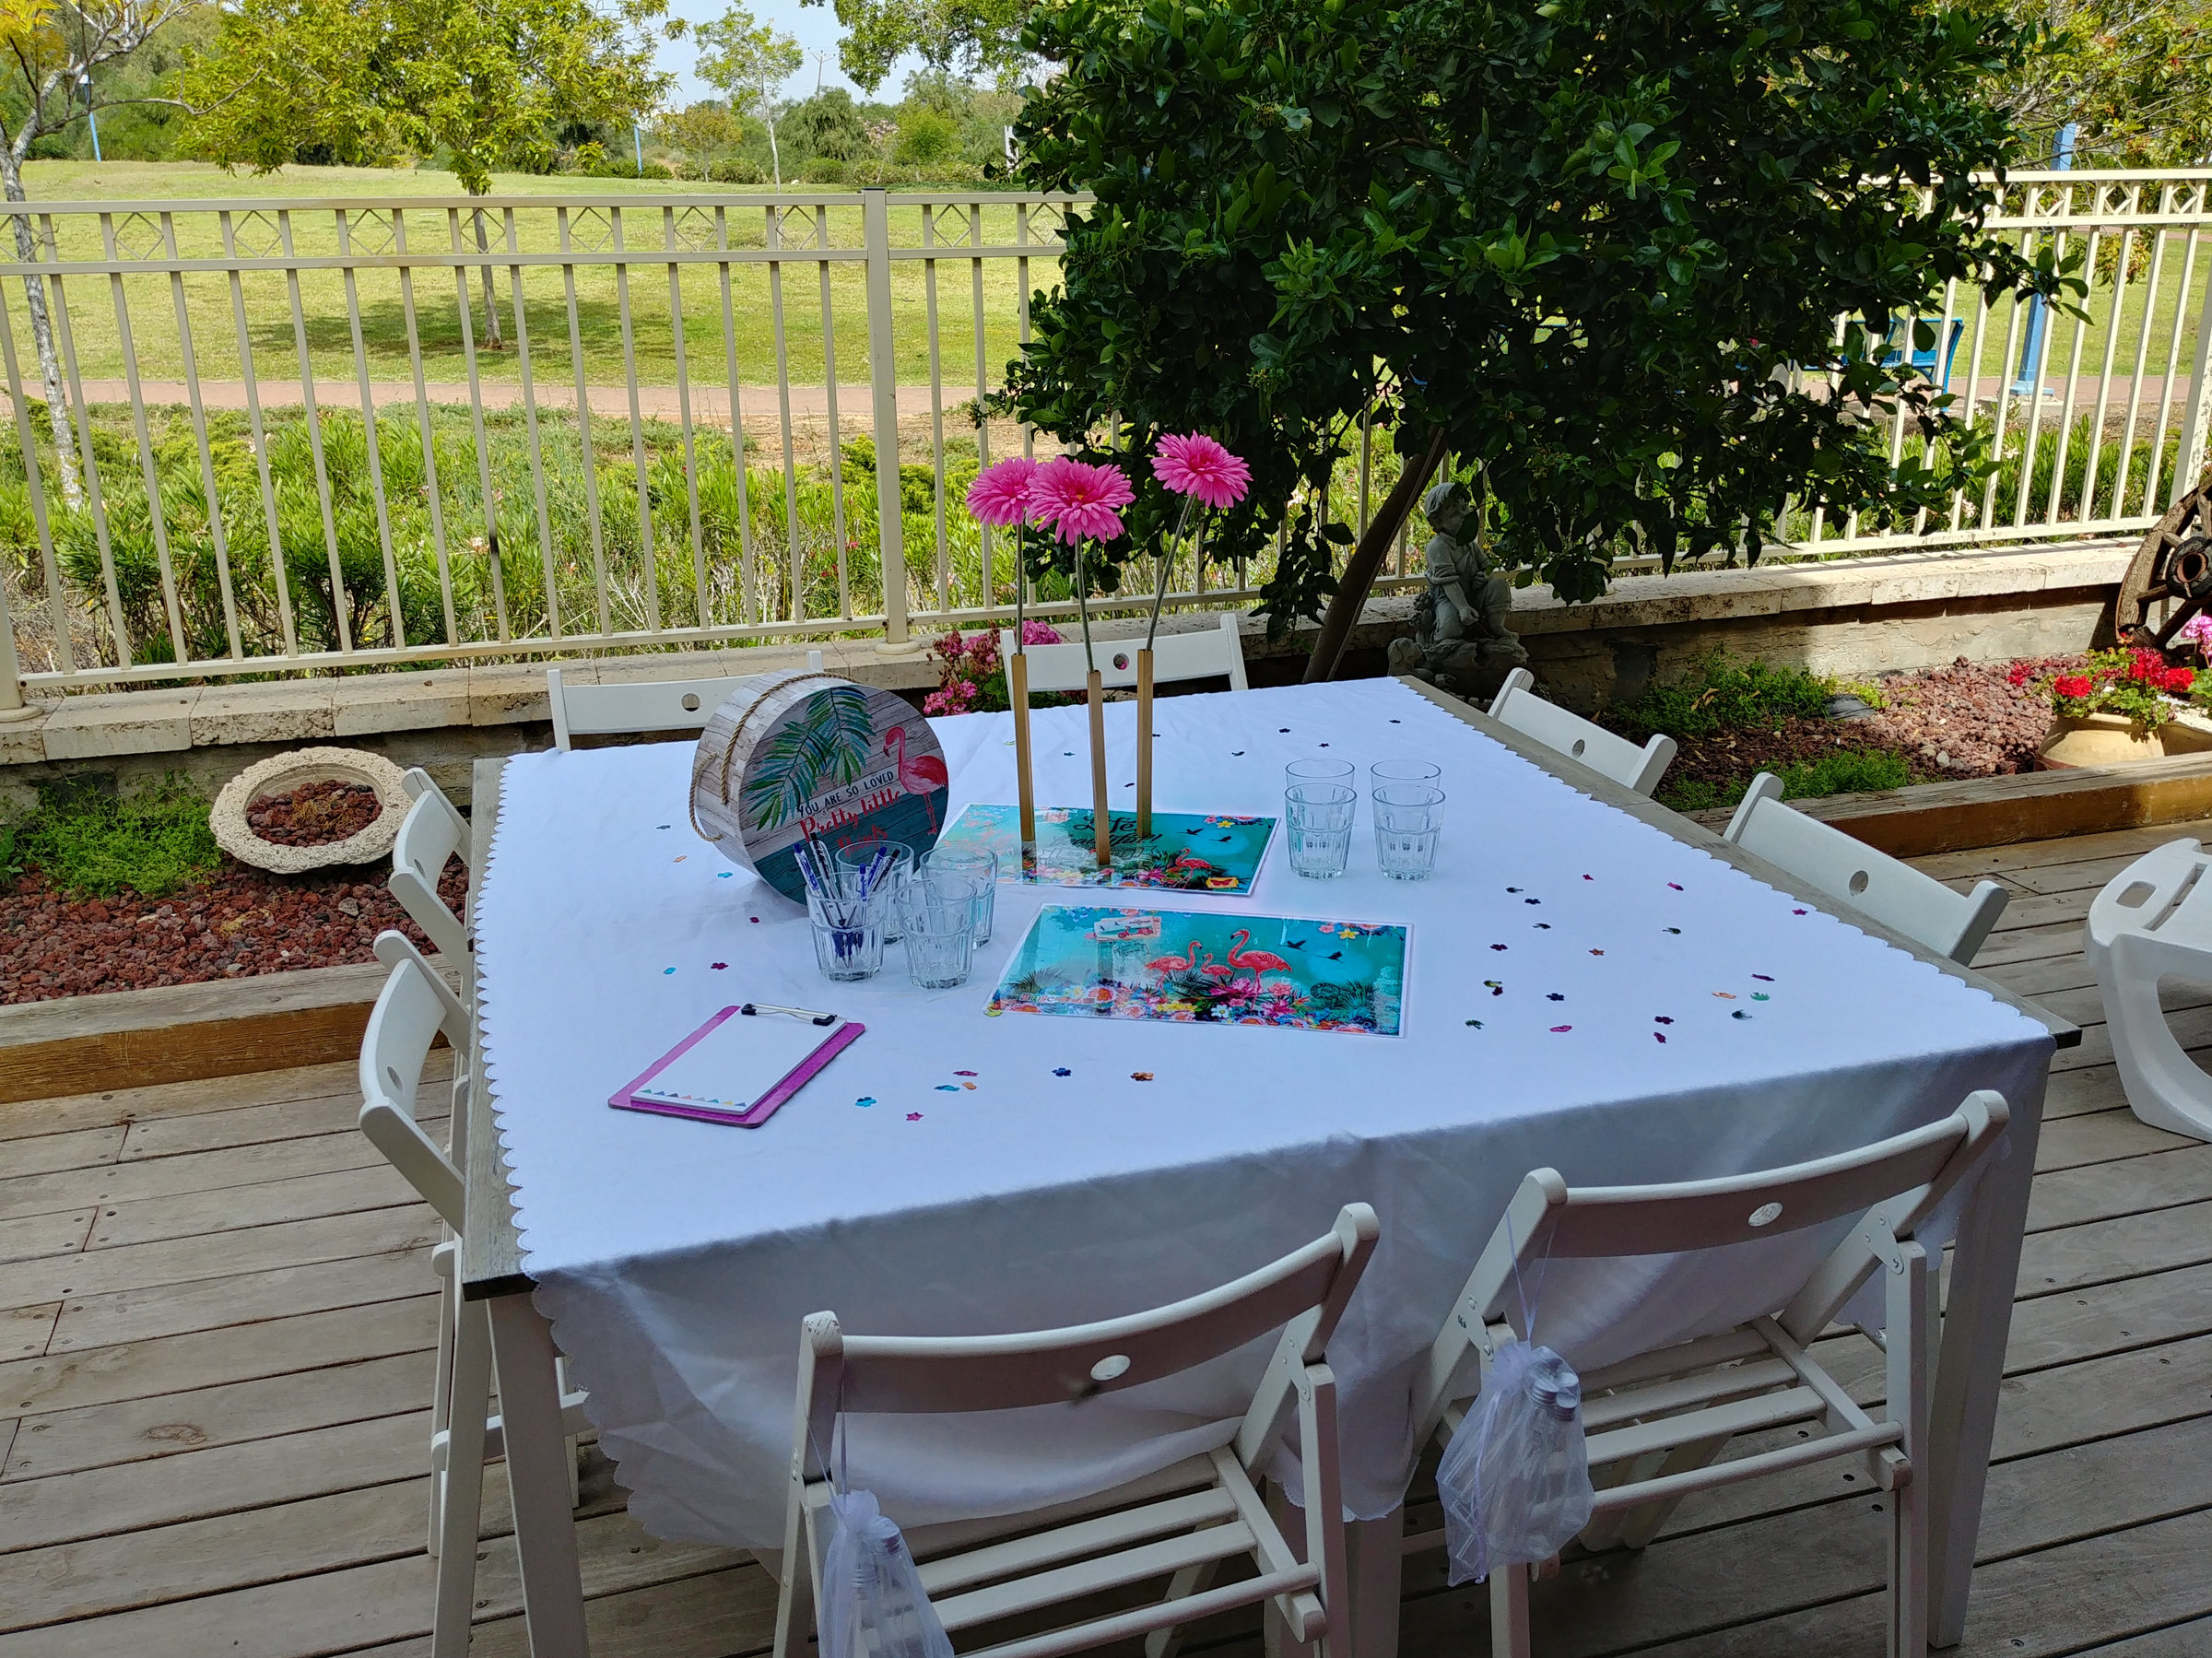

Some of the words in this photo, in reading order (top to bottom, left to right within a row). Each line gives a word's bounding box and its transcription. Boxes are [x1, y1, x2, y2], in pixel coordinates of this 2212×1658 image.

[796, 802, 818, 817] YOU
[824, 793, 841, 807] ARE
[846, 785, 859, 797] SO
[864, 771, 894, 789] LOVED
[799, 807, 859, 842] Pretty
[860, 788, 901, 816] little
[1073, 816, 1137, 834] Lfe
